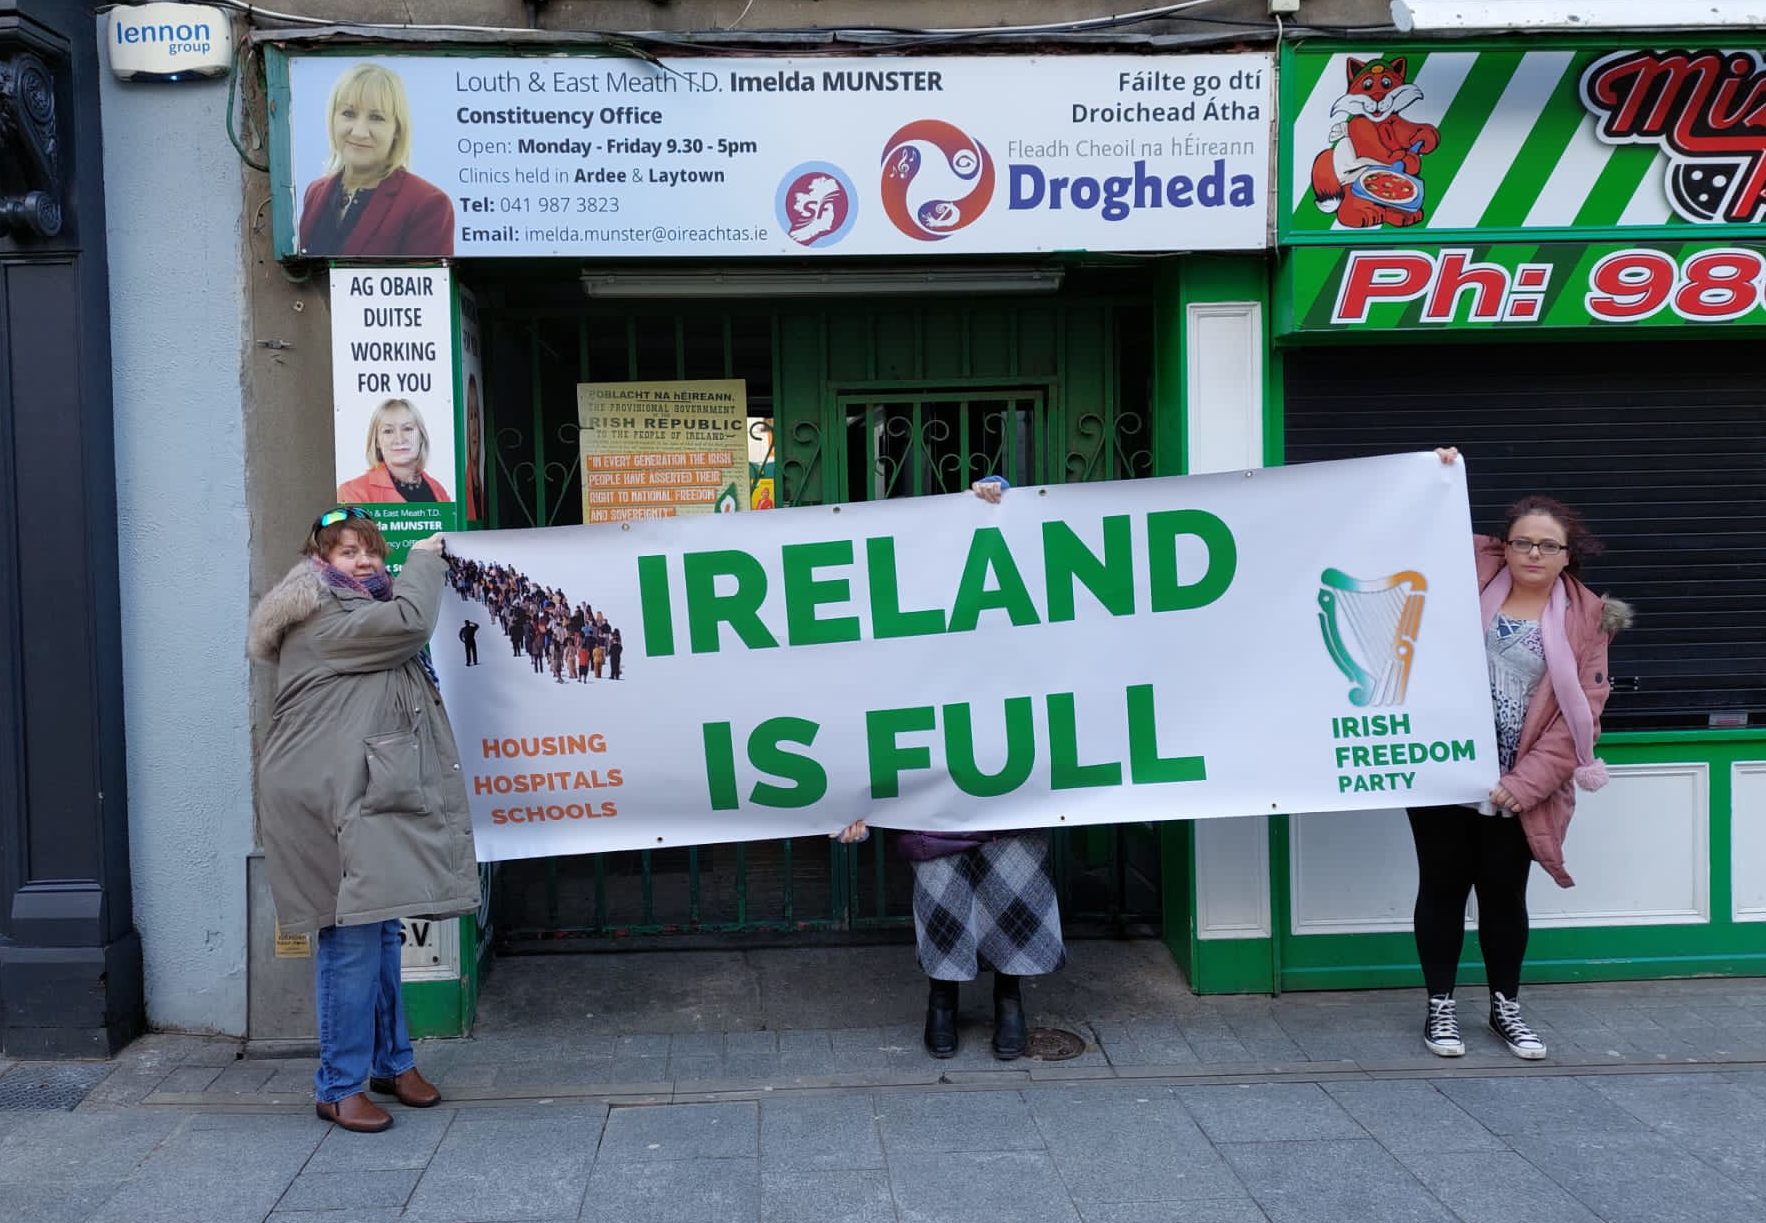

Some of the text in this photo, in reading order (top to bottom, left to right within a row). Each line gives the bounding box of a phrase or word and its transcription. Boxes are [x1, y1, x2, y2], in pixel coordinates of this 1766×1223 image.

[117, 22, 210, 44] lennon
[169, 43, 210, 56] group
[456, 71, 944, 93] Louth & East Meath T.D. Imelda MUNSTER
[1119, 70, 1262, 96] Fáilte go dtí
[456, 107, 663, 130] Constituency Office
[1072, 98, 1260, 123] Droichead Átha
[457, 138, 513, 158] Open:
[518, 138, 593, 158] Monday
[607, 138, 662, 157] Friday
[667, 138, 703, 154] 9.30
[718, 138, 757, 158] 5pm
[1009, 133, 1254, 158] Fleadh Cheoil na hÉireann
[459, 167, 725, 187] Clinics held in Ardee & Laytown
[1008, 159, 1255, 222] Drogheda
[460, 197, 620, 213] Tel: 041 987 3823
[461, 226, 768, 244] Email: imelda.munster@oireachtas.ie
[350, 276, 433, 296] AG OBAIR
[1333, 249, 1766, 322] Ph: 98
[364, 308, 422, 327] DUITSE
[351, 342, 436, 361] WORKING
[358, 373, 431, 393] FOR YOU
[654, 391, 670, 400] NA
[610, 403, 669, 413] PROVISIONAL
[644, 418, 742, 430] REPUBLIC
[604, 455, 631, 468] EVERY
[634, 453, 686, 466] GENERATION
[689, 453, 705, 465] THE
[708, 452, 732, 465] IRISH
[589, 470, 721, 485] PEOPLE HAVE ASSERTED THEIR
[618, 491, 629, 502] TO
[631, 490, 672, 502] NATIONAL
[675, 489, 716, 501] FREEDOM
[383, 509, 399, 517] East
[401, 509, 425, 517] Meath
[591, 509, 608, 521] AND
[390, 521, 443, 531] MUNSTER
[638, 509, 1237, 657] IRELAND
[1332, 714, 1411, 739] IRISH
[482, 733, 607, 759] HOUSING
[703, 683, 1207, 811] IS FULL
[1335, 739, 1476, 768] FREEDOM
[474, 769, 624, 795] HOSPITALS
[1339, 772, 1416, 793] PARTY
[491, 802, 618, 825] SCHOOLS
